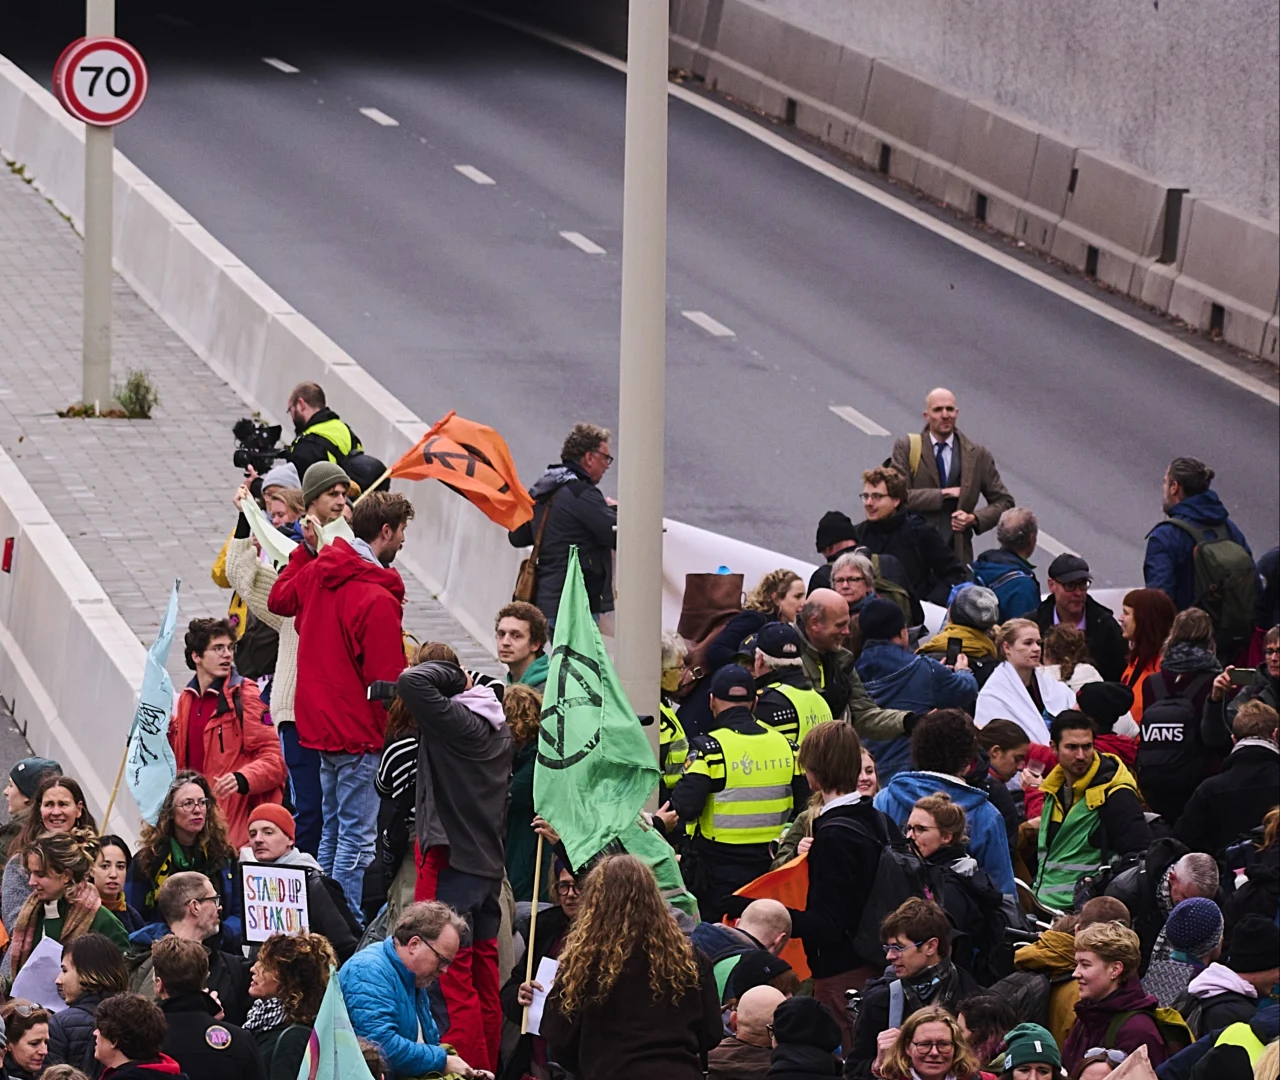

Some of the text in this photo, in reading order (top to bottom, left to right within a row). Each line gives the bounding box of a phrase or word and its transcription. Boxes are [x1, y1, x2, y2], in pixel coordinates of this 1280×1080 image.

[80, 66, 131, 97] 70
[1141, 723, 1185, 742] VANS
[246, 874, 302, 904] STAND UP
[248, 905, 304, 933] SPEAK OUT
